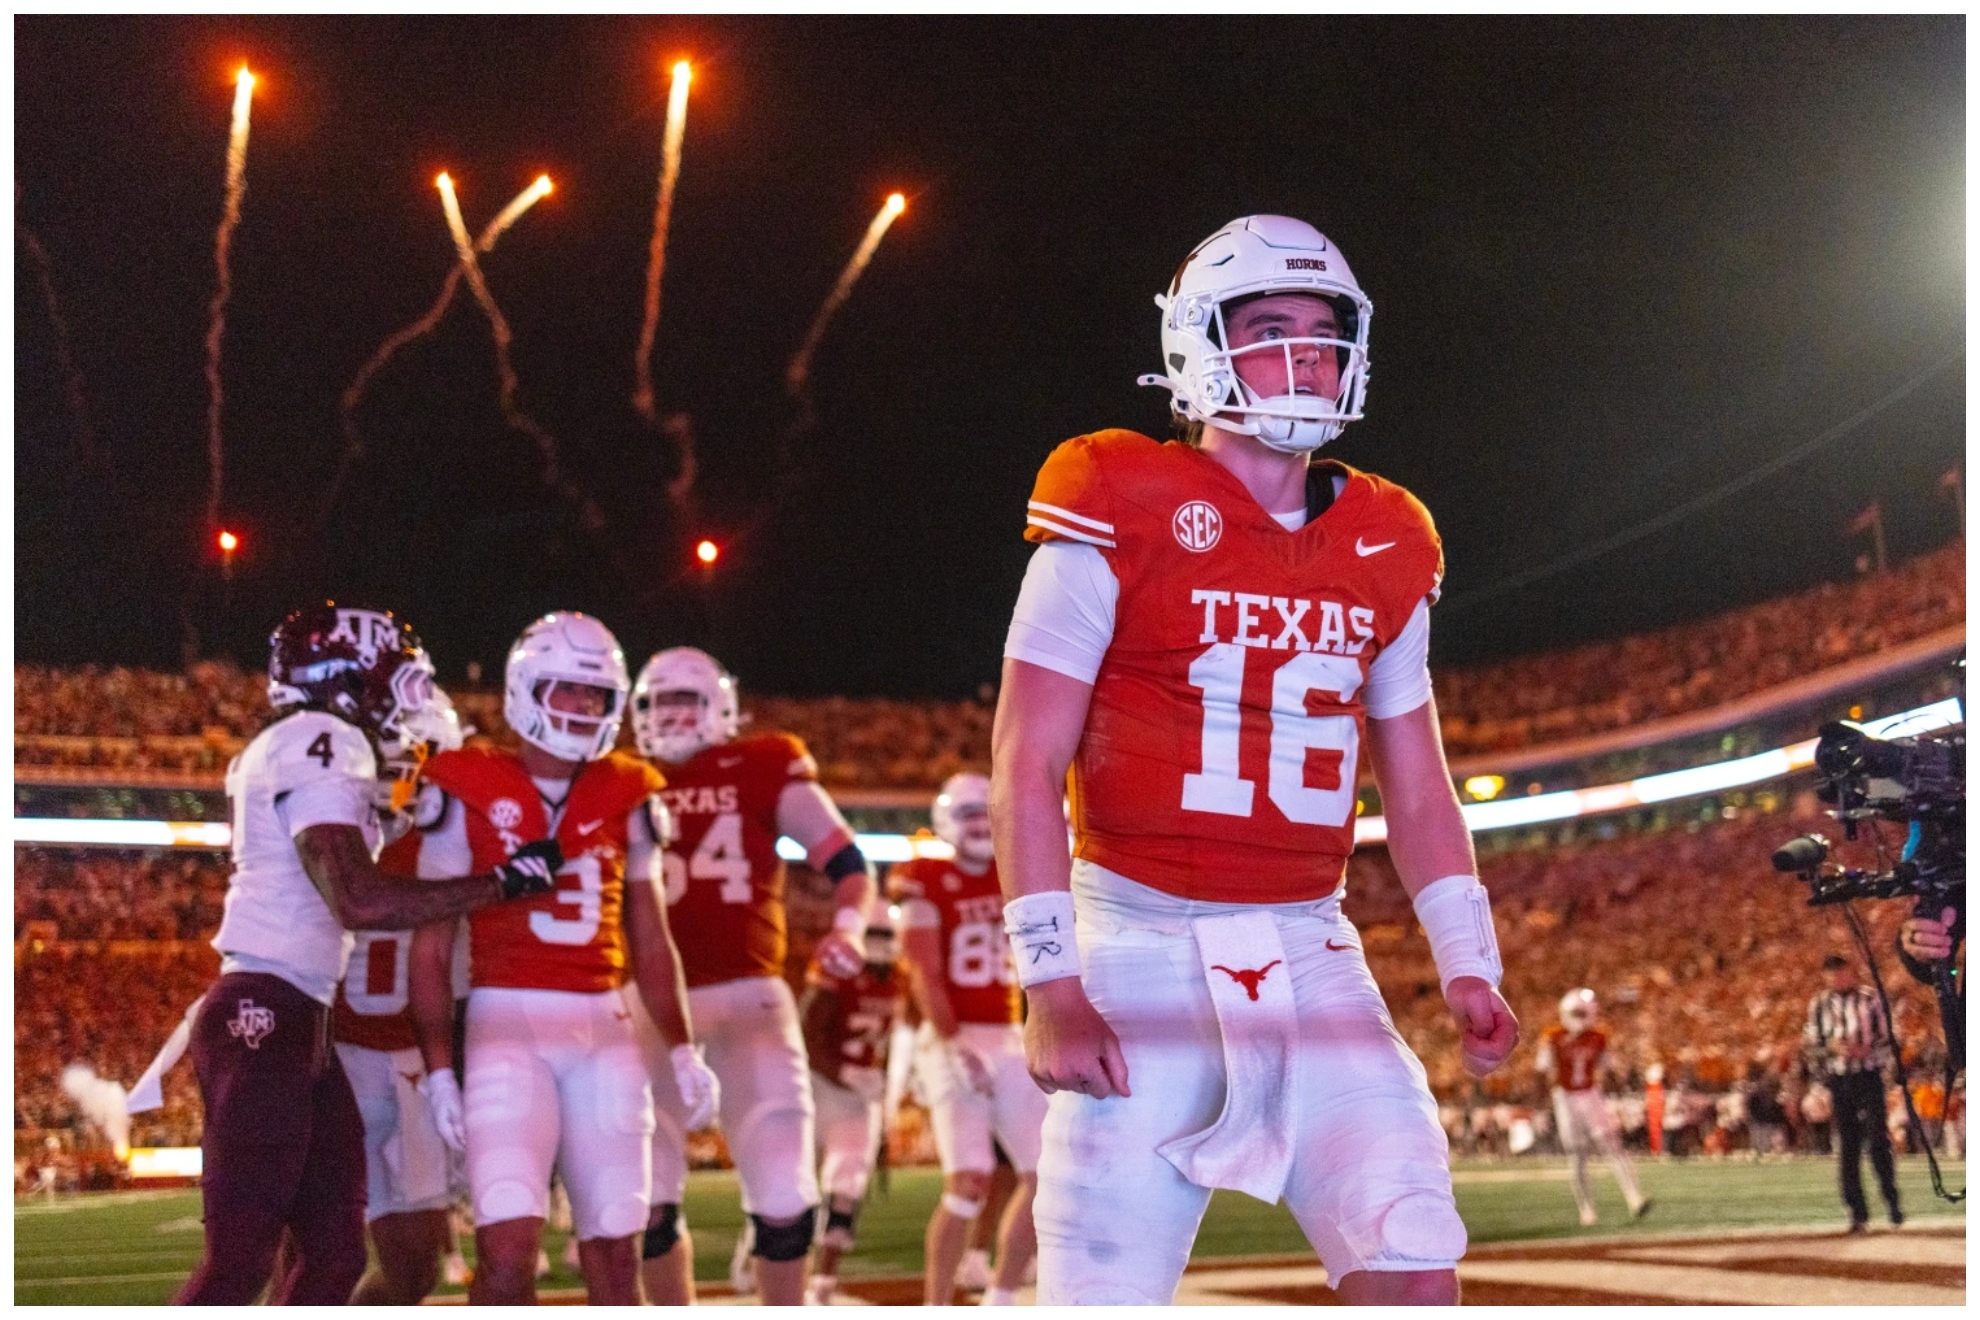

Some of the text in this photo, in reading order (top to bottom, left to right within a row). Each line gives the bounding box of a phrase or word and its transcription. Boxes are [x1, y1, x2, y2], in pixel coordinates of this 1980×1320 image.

[1285, 259, 1327, 271] HORNS
[1176, 504, 1218, 548] SEC
[1191, 589, 1375, 654] TEXAS
[306, 731, 335, 768] 4
[1181, 642, 1363, 827] 16
[658, 785, 739, 814] XAS
[528, 851, 602, 946] 3
